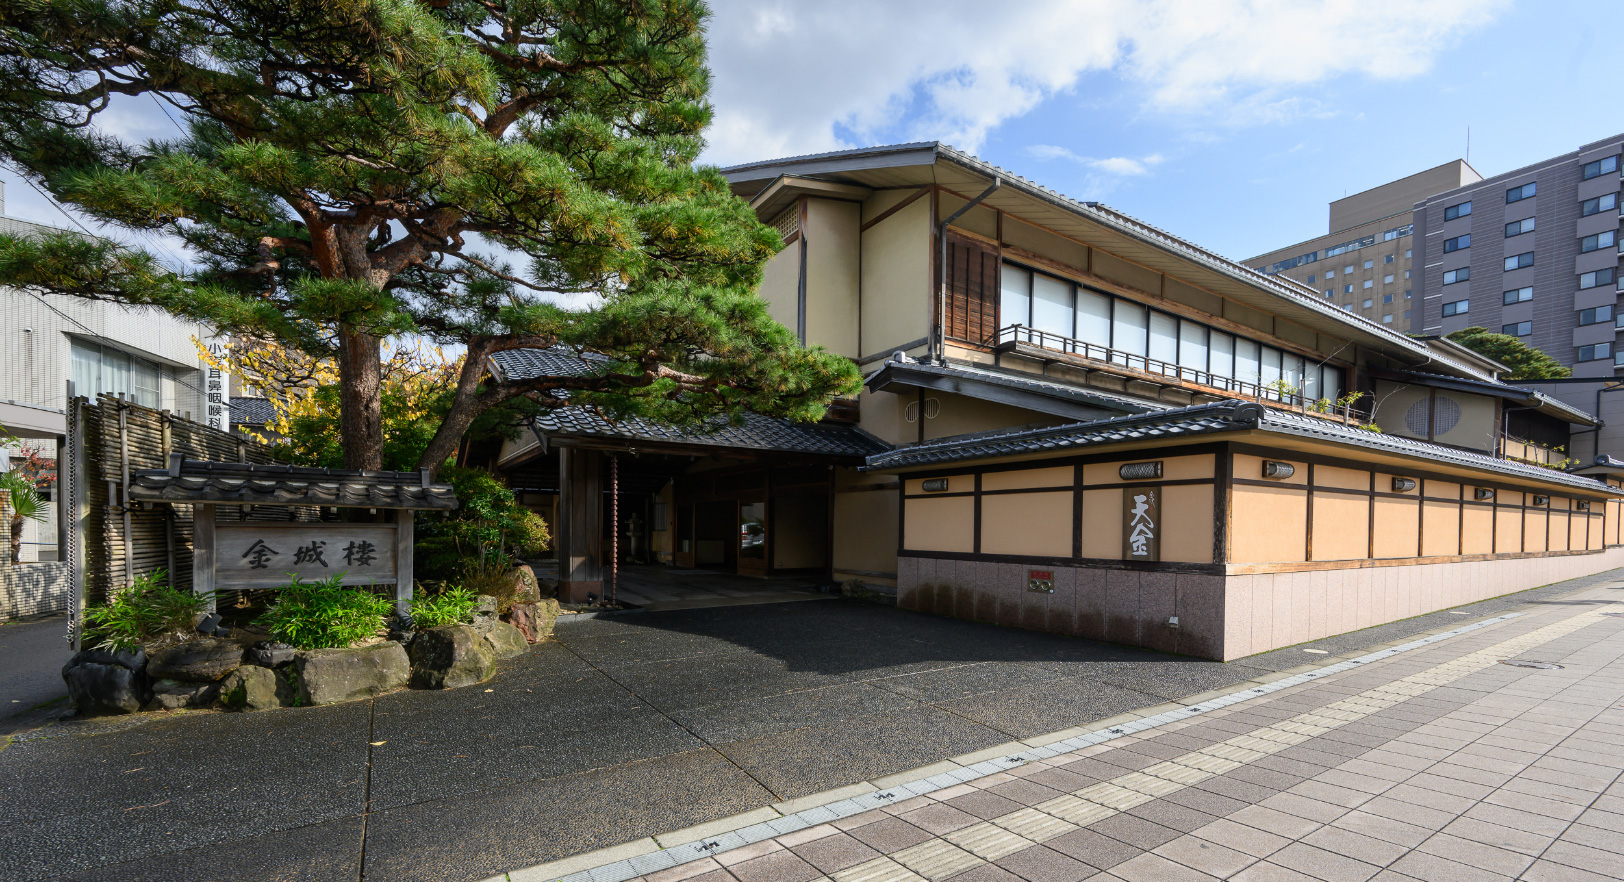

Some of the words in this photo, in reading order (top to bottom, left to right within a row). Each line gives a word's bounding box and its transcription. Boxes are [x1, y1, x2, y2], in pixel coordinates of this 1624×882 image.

[208, 342, 222, 429] 小耳鼻咽喉科
